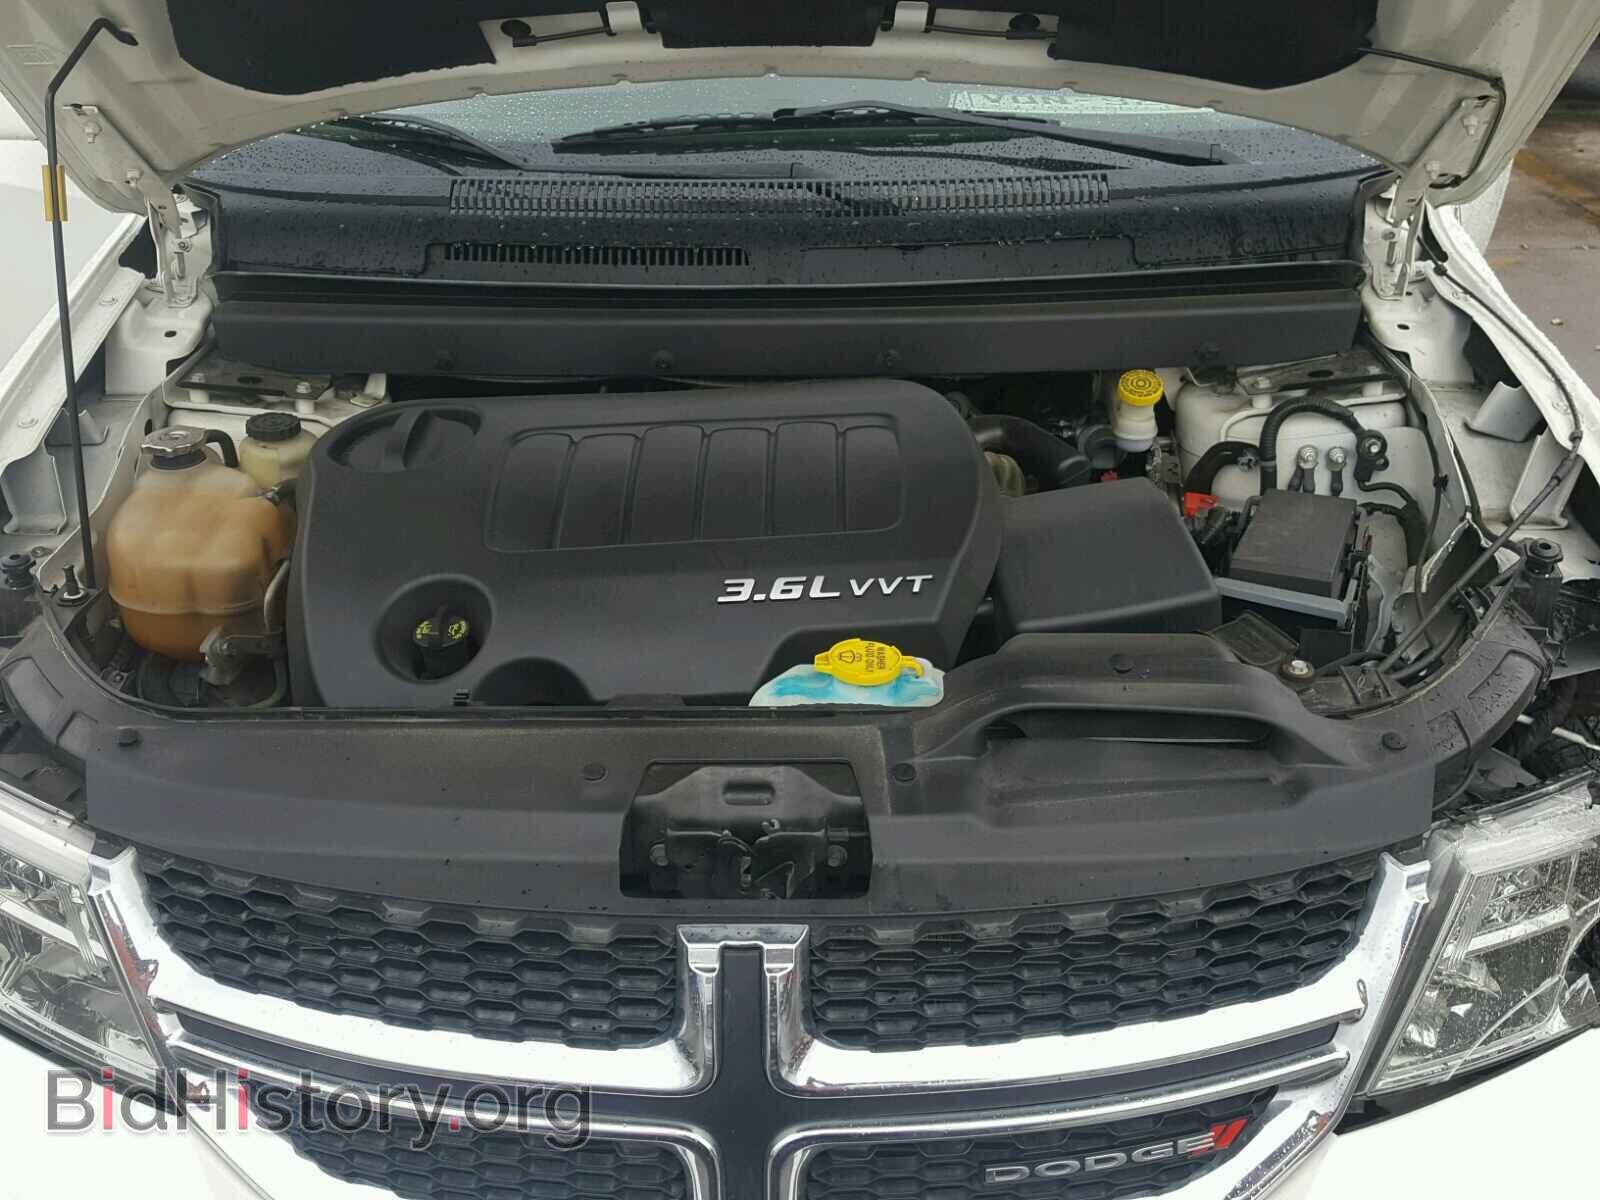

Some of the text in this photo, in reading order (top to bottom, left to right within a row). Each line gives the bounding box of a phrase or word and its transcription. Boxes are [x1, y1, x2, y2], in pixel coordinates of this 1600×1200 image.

[717, 574, 934, 603] 3.6L VVT
[984, 1131, 1216, 1184] DODGE
